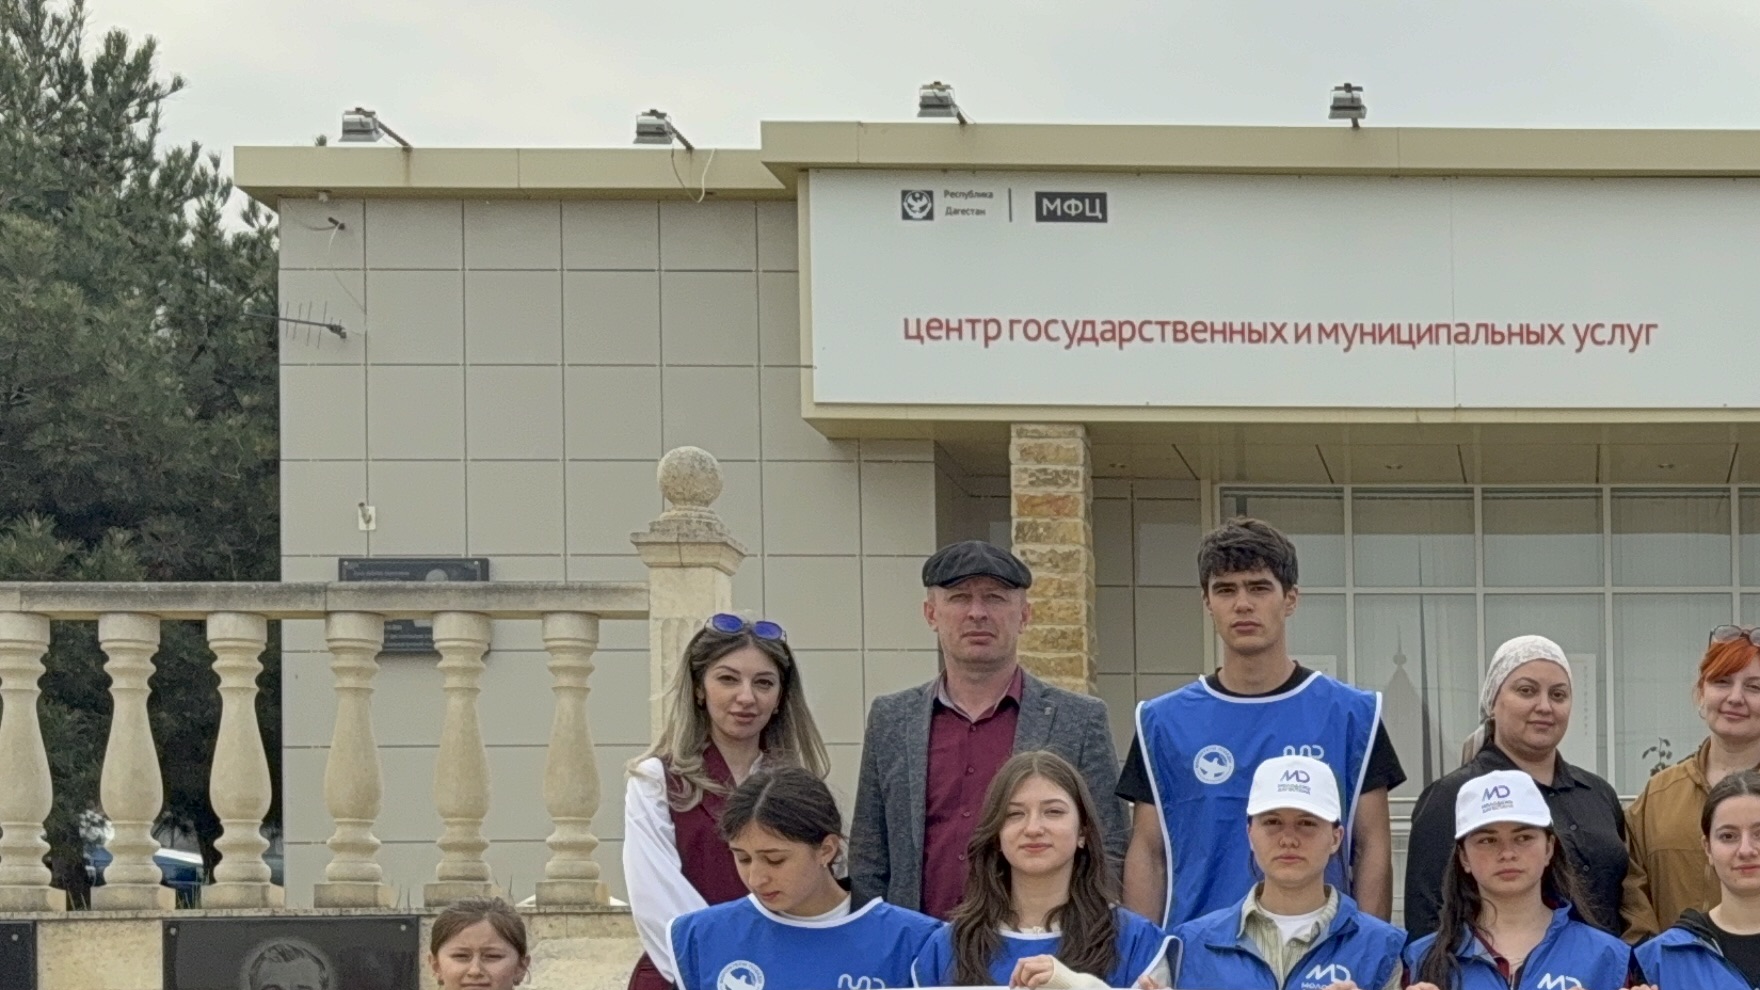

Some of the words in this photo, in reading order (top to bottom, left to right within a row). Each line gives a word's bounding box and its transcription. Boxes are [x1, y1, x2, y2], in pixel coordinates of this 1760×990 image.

[943, 189, 994, 200] Республика
[944, 206, 987, 217] Дагестан
[1042, 198, 1103, 219] МФЦ
[903, 314, 1002, 349] центр
[1008, 317, 1289, 352] государственных
[1295, 322, 1314, 344] и
[1318, 320, 1565, 352] муниципальных
[1573, 321, 1659, 354] услуг
